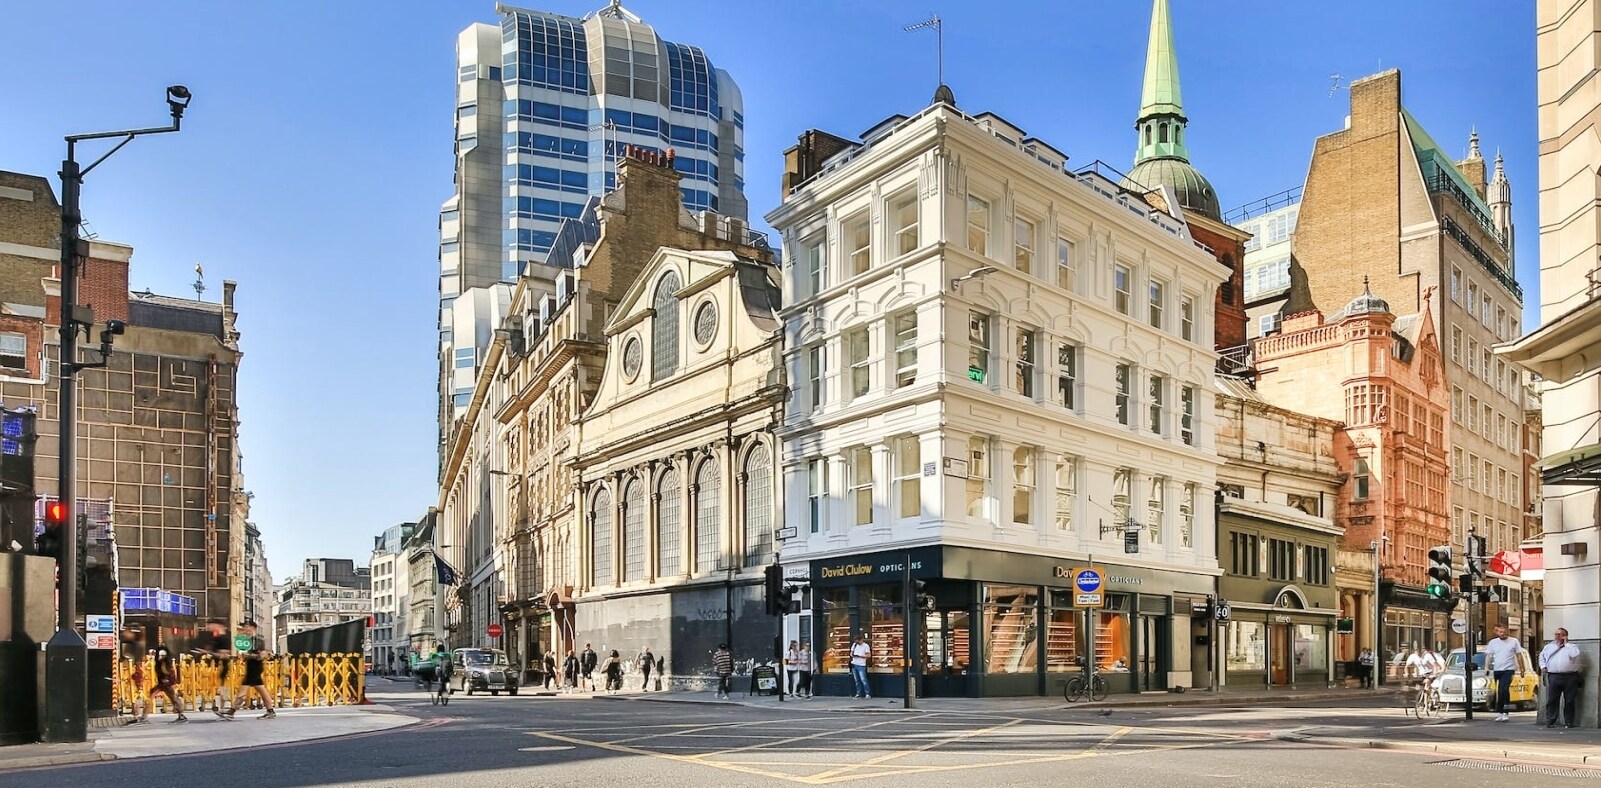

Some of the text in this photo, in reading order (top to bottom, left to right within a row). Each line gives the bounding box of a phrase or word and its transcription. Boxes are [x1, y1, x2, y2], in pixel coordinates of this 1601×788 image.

[822, 562, 922, 578] David Clulow OPTICNS
[1057, 566, 1074, 579] Dav
[1110, 575, 1143, 585] OPTICIANS
